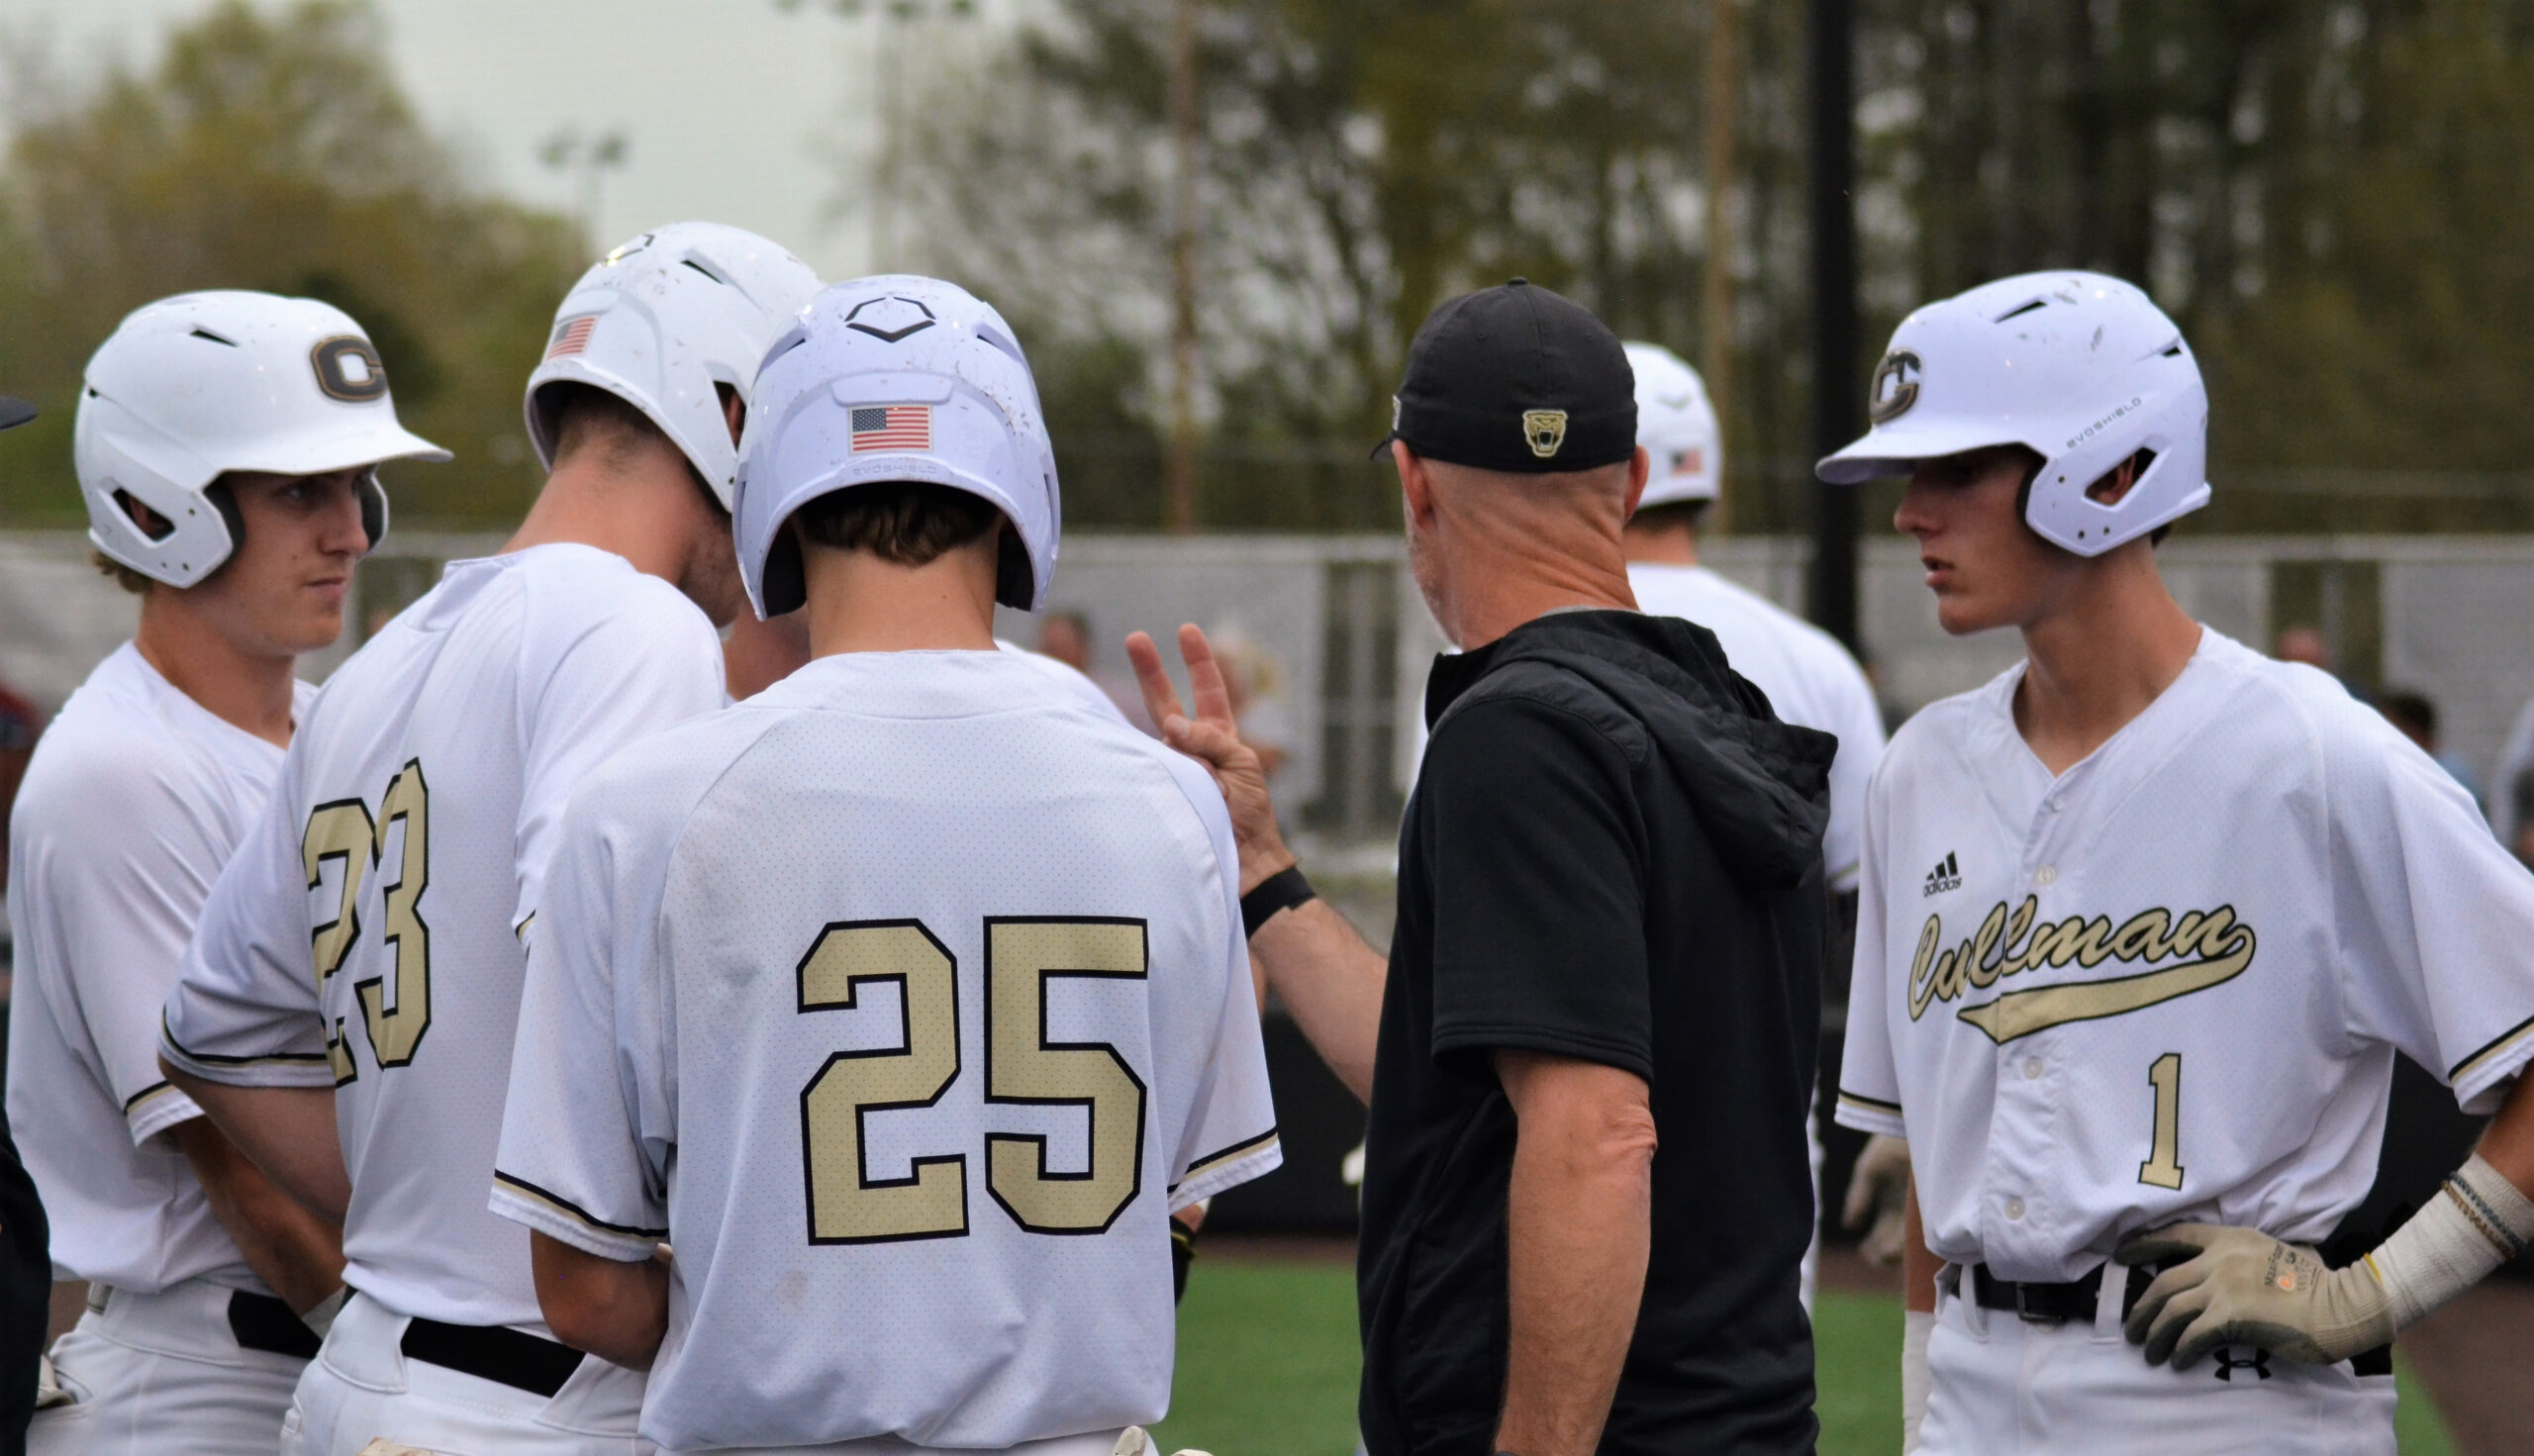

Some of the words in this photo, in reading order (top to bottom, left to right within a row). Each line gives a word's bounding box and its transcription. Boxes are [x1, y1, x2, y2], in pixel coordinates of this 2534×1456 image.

[2066, 397, 2142, 449] EVOSHIELD
[301, 756, 432, 1088] 23
[1923, 877, 1962, 898] adidas
[1907, 893, 2256, 1021] Cullman
[796, 915, 1148, 1246] 25
[2138, 1052, 2184, 1191] 1
